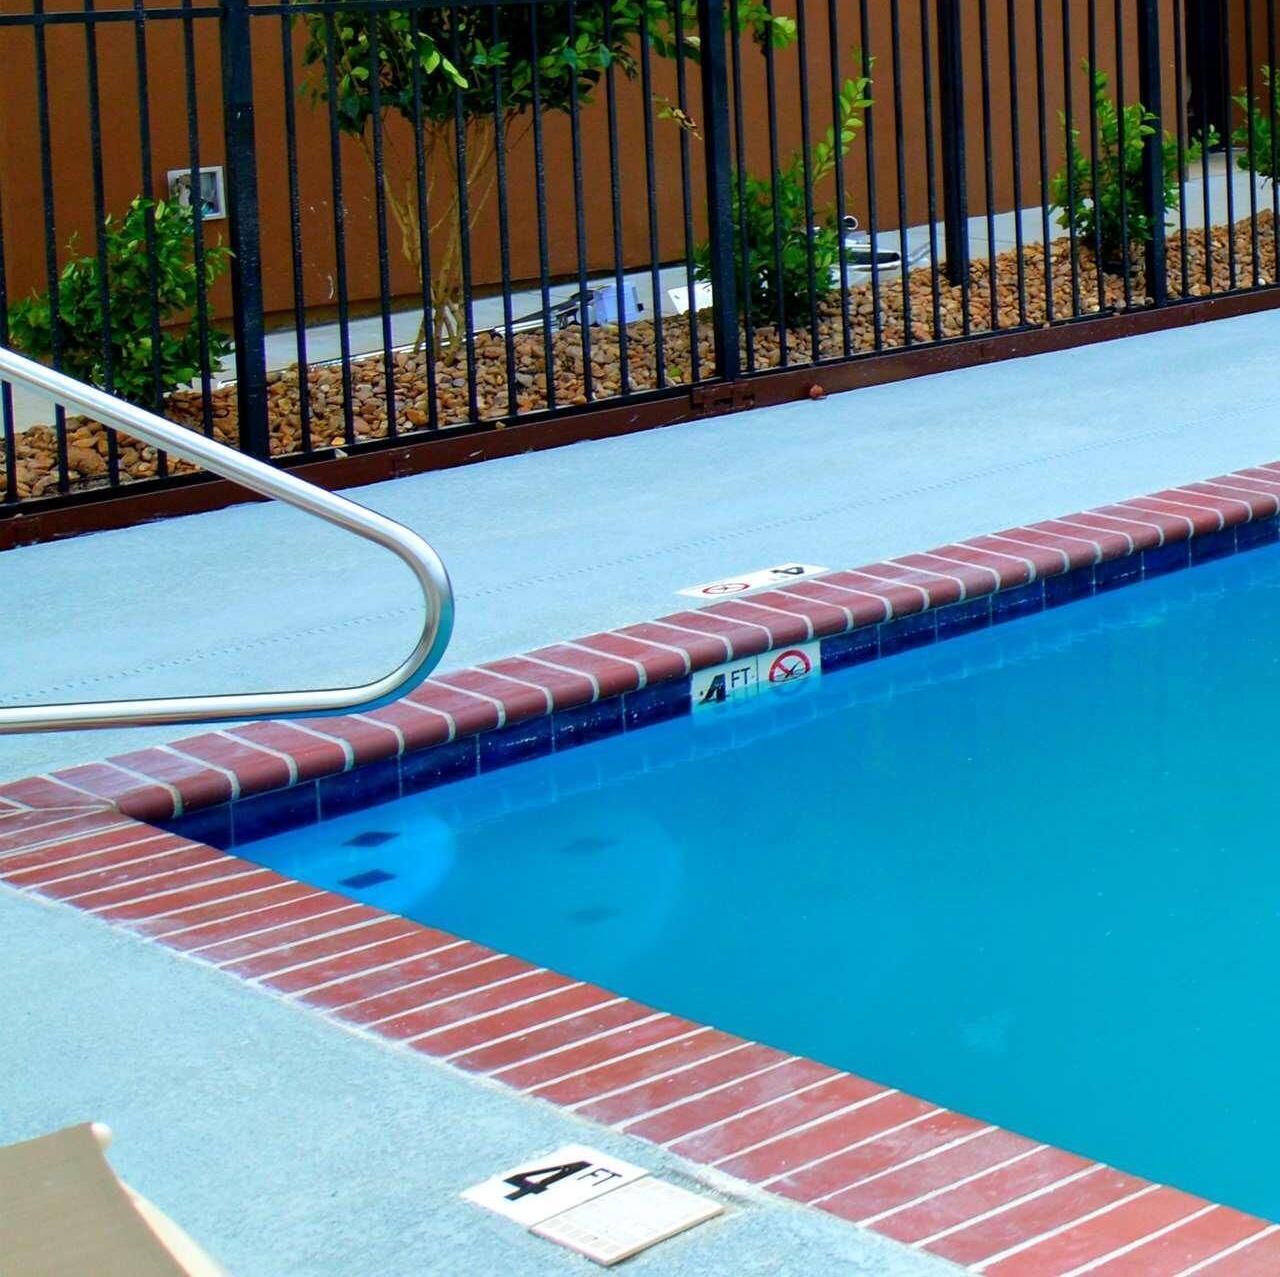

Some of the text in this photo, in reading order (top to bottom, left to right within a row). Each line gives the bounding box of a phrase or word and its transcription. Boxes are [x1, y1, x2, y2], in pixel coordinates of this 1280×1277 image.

[731, 667, 751, 689] FT
[502, 1160, 624, 1201] 4 FT
